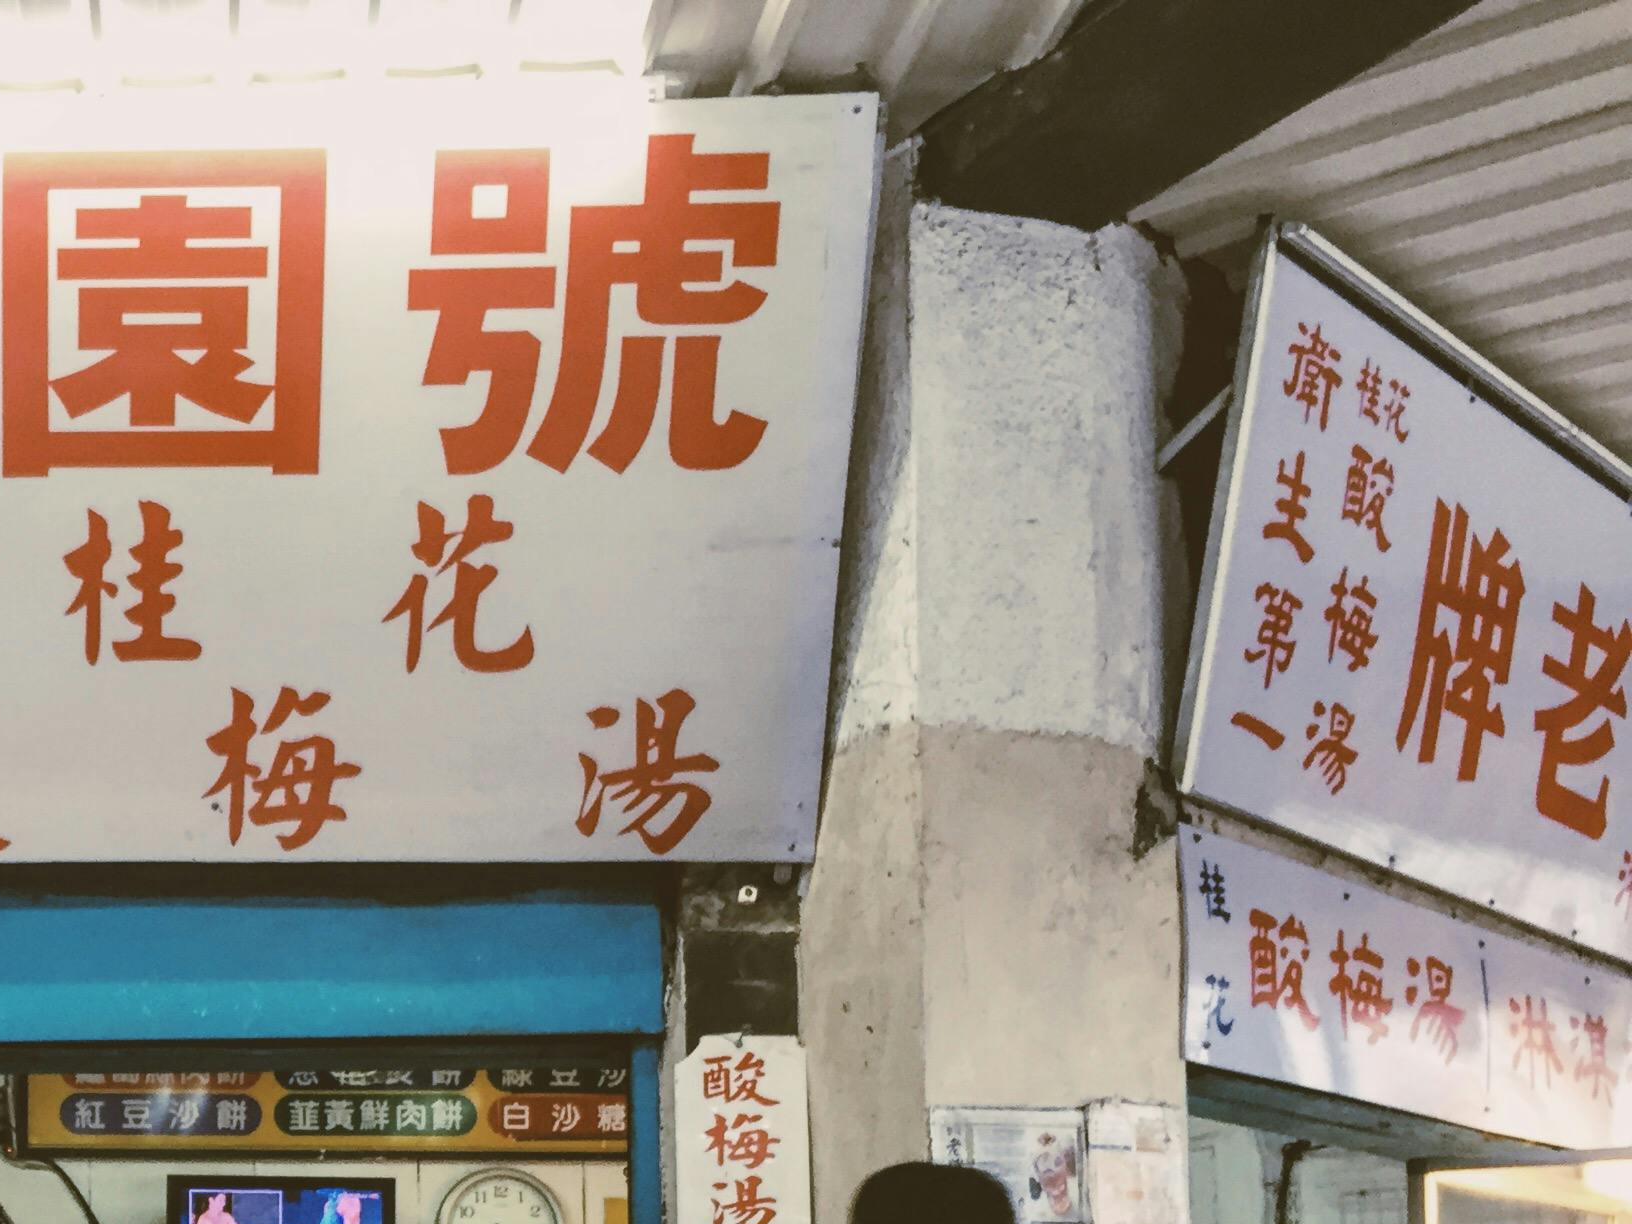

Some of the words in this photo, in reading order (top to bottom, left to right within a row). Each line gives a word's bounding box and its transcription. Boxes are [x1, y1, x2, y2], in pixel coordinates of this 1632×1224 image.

[62, 493, 535, 675] 桂花
[1230, 321, 1342, 752] 衛生第一
[1248, 907, 1466, 1065] 酸梅湯
[75, 1098, 247, 1130] 紅豆沙餅
